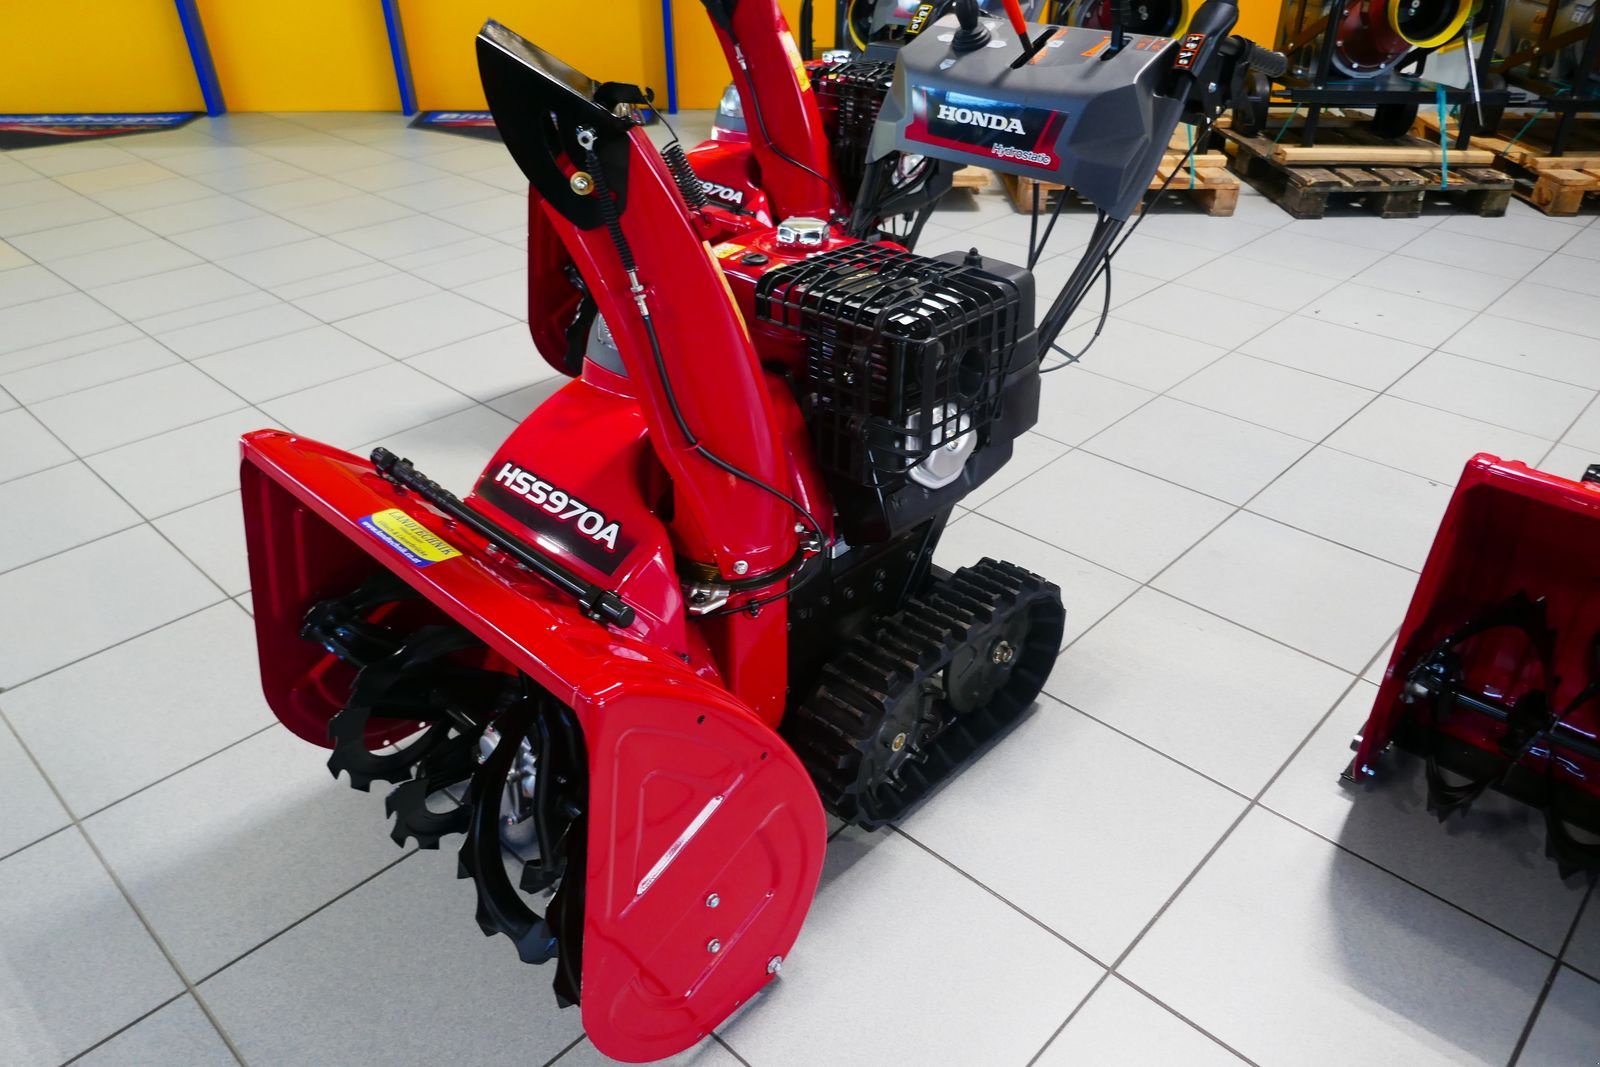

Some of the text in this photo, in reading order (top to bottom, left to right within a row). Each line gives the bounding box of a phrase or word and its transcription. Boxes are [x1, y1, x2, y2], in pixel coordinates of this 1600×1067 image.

[937, 104, 1026, 135] HONDA
[991, 142, 1051, 165] Hydrostatic
[697, 180, 743, 204] 970A
[495, 462, 620, 550] HSS970A
[389, 511, 453, 556] LANDTECHNIK
